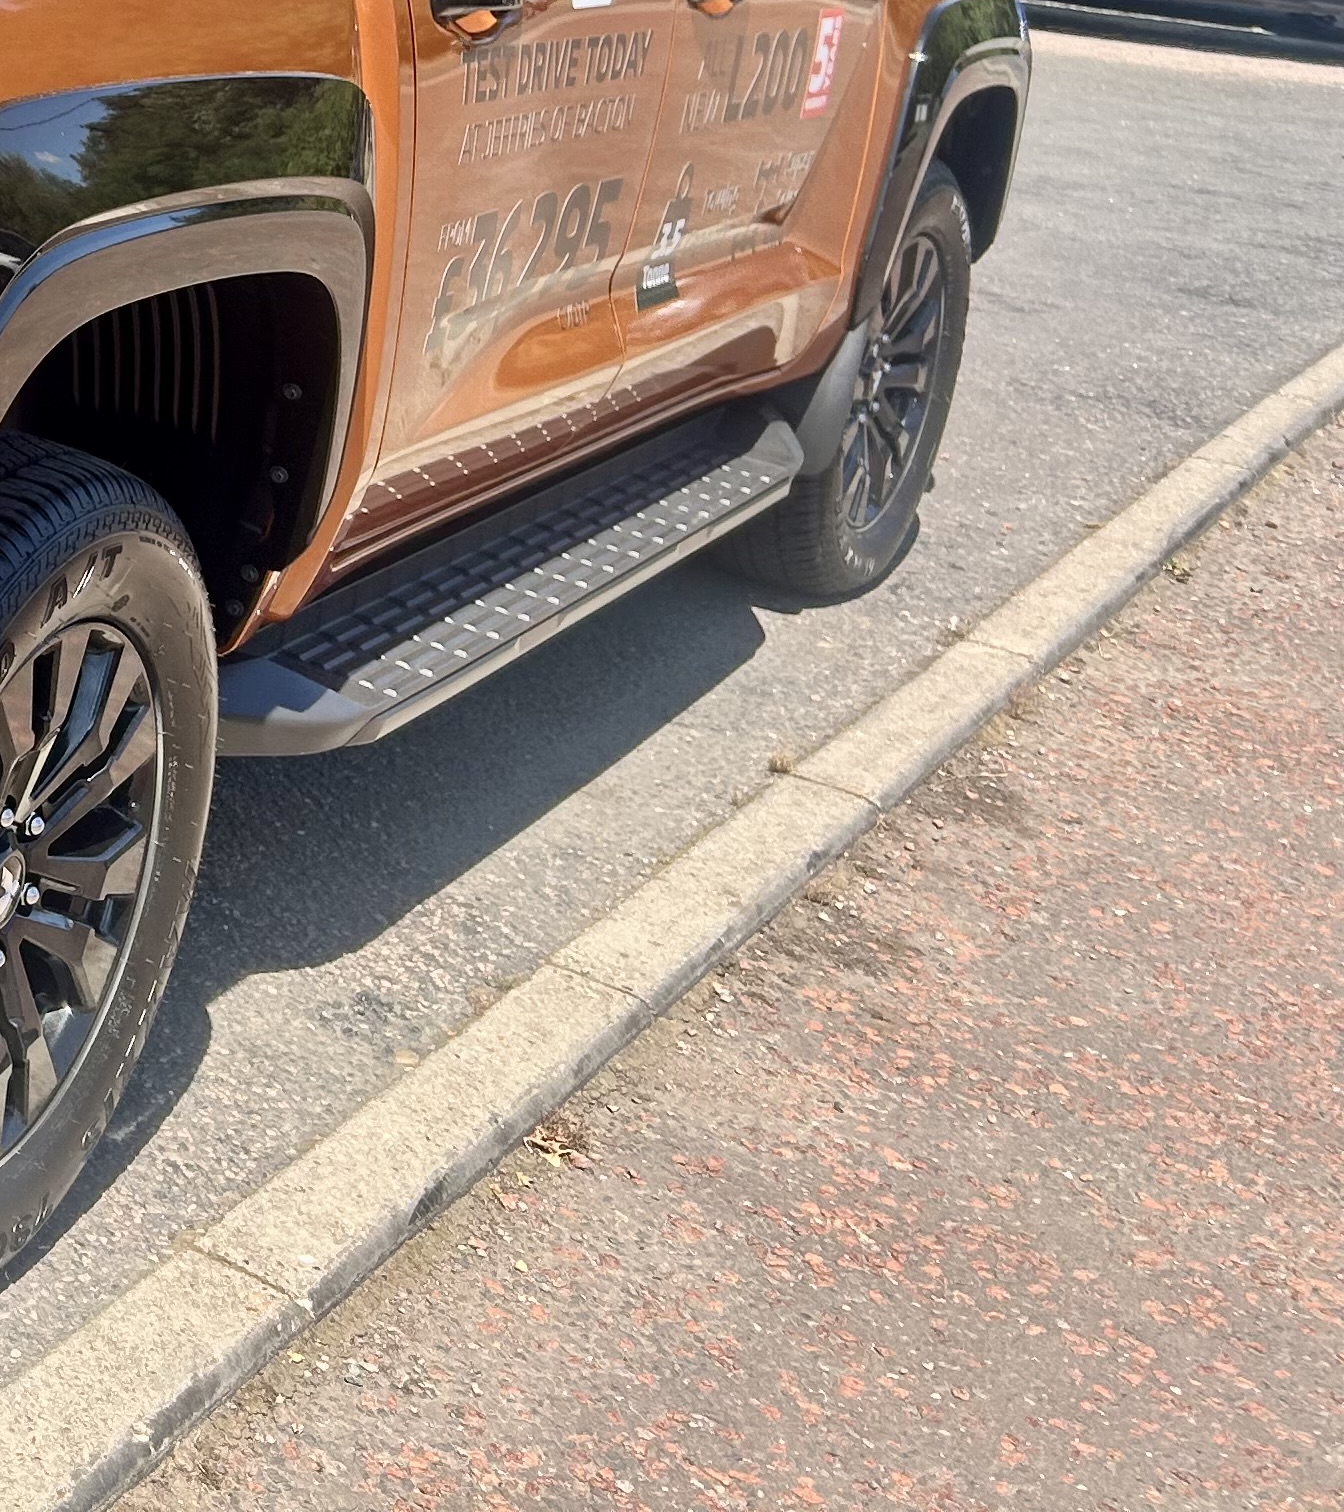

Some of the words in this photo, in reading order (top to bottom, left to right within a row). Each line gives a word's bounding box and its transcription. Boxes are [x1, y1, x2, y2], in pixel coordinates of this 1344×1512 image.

[460, 44, 516, 105] TEST
[514, 38, 582, 97] DRIVE
[583, 28, 654, 87] TODAY
[720, 26, 810, 125] L200
[457, 122, 483, 166] AT
[480, 106, 550, 161] JEFFRIES
[549, 104, 575, 143] OF
[571, 92, 638, 140] BACTON
[39, 543, 124, 630] A/T
